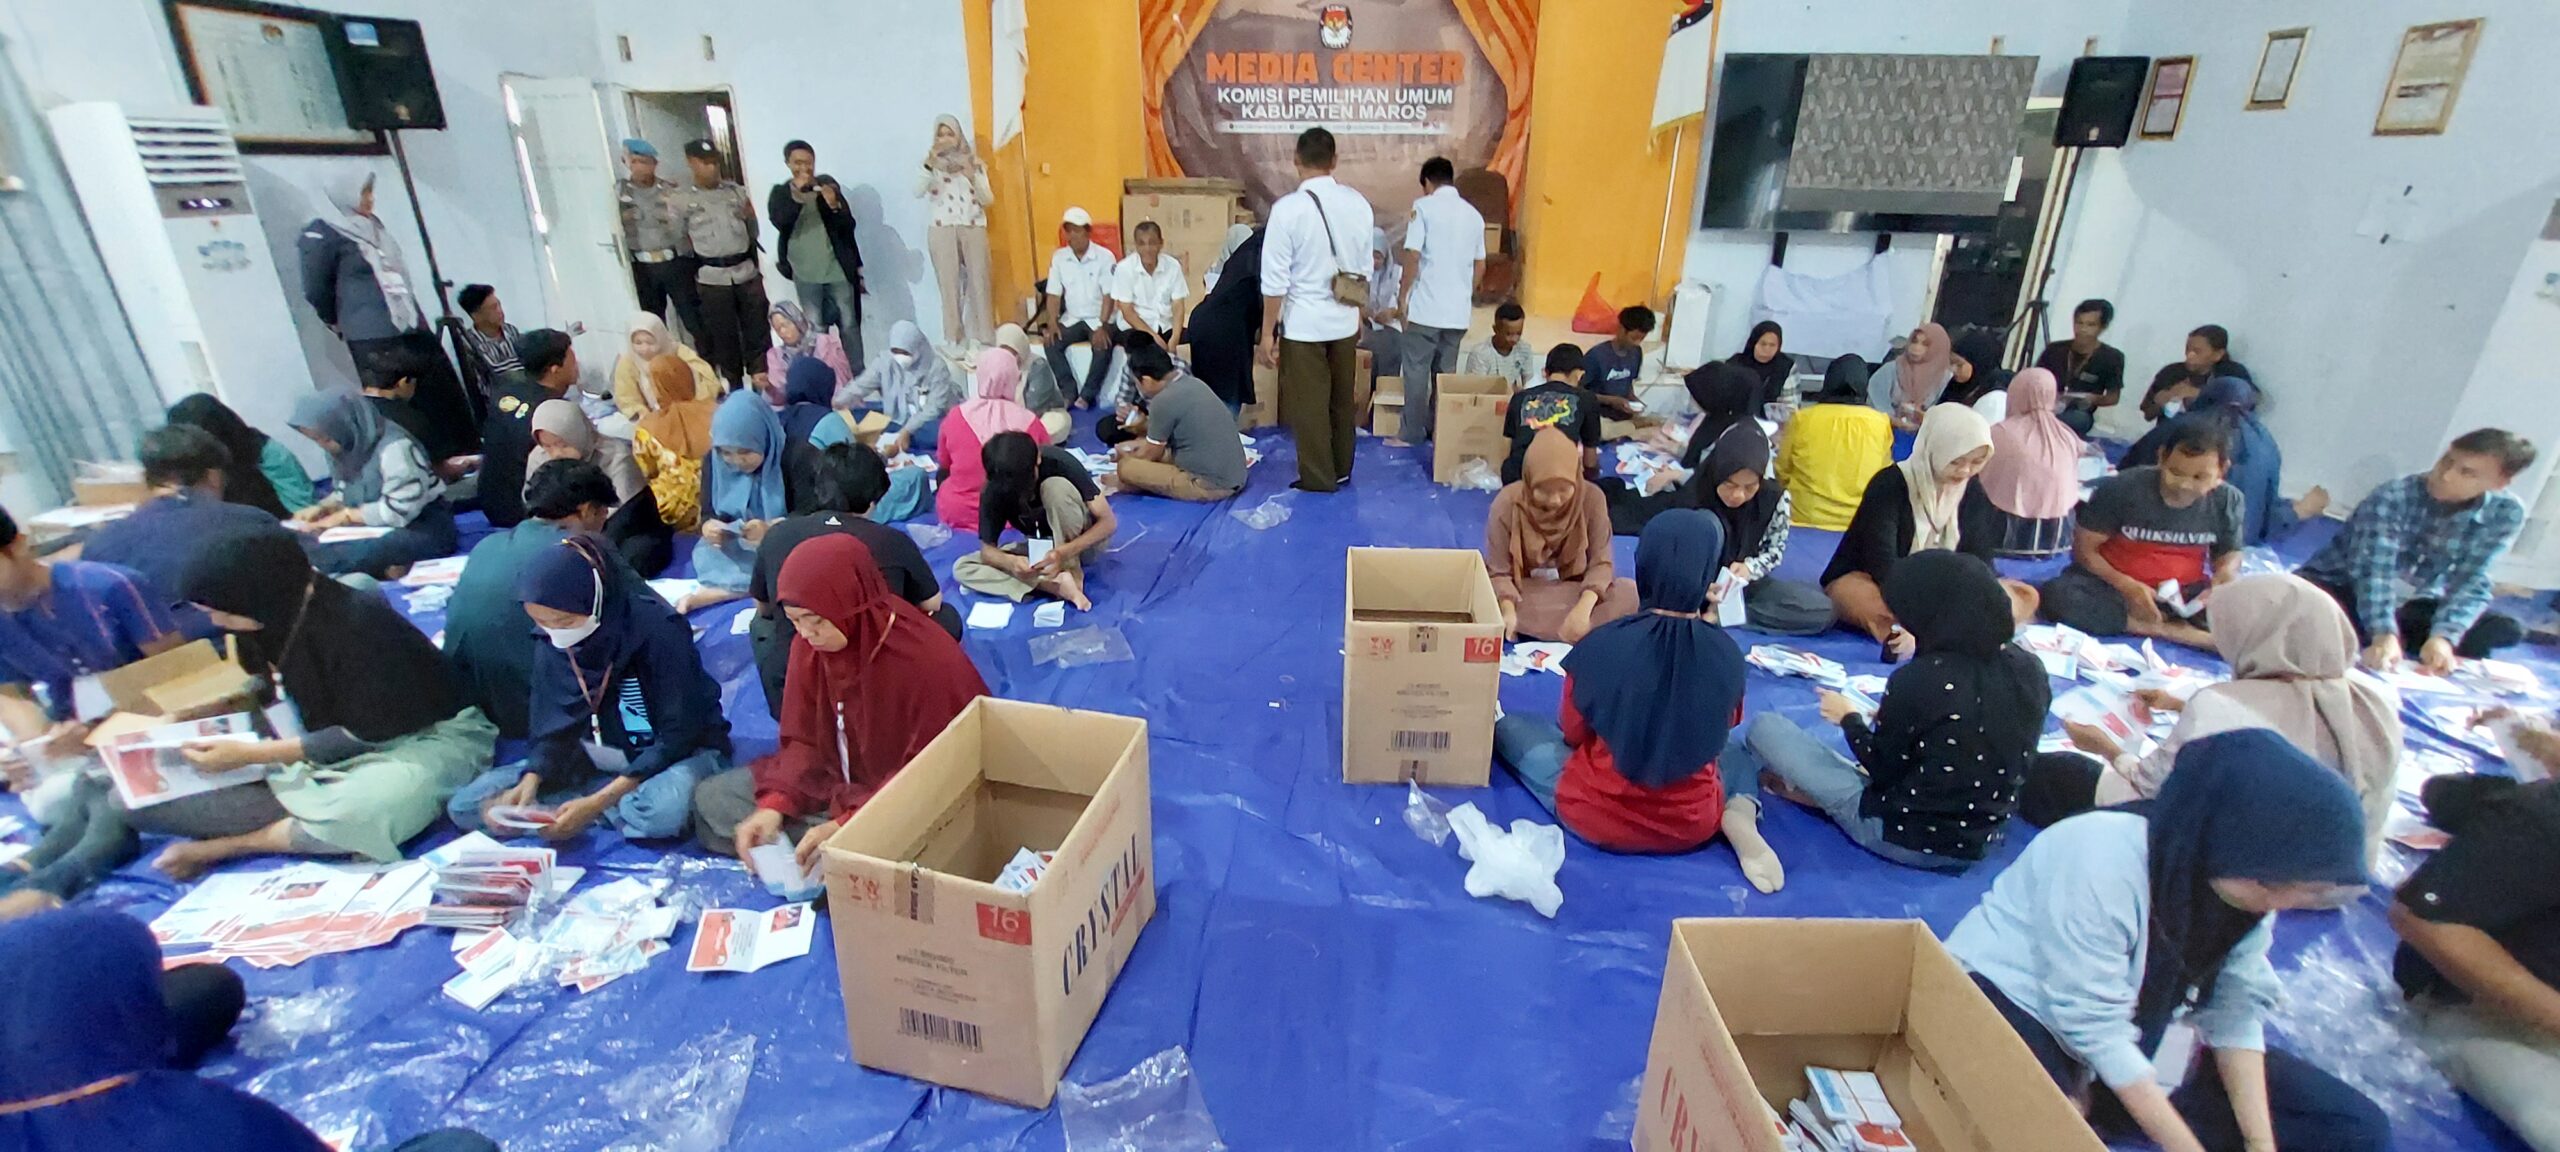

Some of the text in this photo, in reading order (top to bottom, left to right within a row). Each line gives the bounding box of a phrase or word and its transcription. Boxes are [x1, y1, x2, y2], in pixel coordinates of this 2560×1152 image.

[1206, 50, 1465, 85] MEDIA CENTER
[1218, 88, 1453, 104] KOMISI PEMILIHAN UMUM
[1241, 104, 1427, 120] KABUPATEN MAROS
[2121, 526, 2218, 544] QUIKSILVER
[1472, 637, 1495, 656] 16
[989, 905, 1020, 932] 16
[1062, 833, 1141, 997] CRYSTAL
